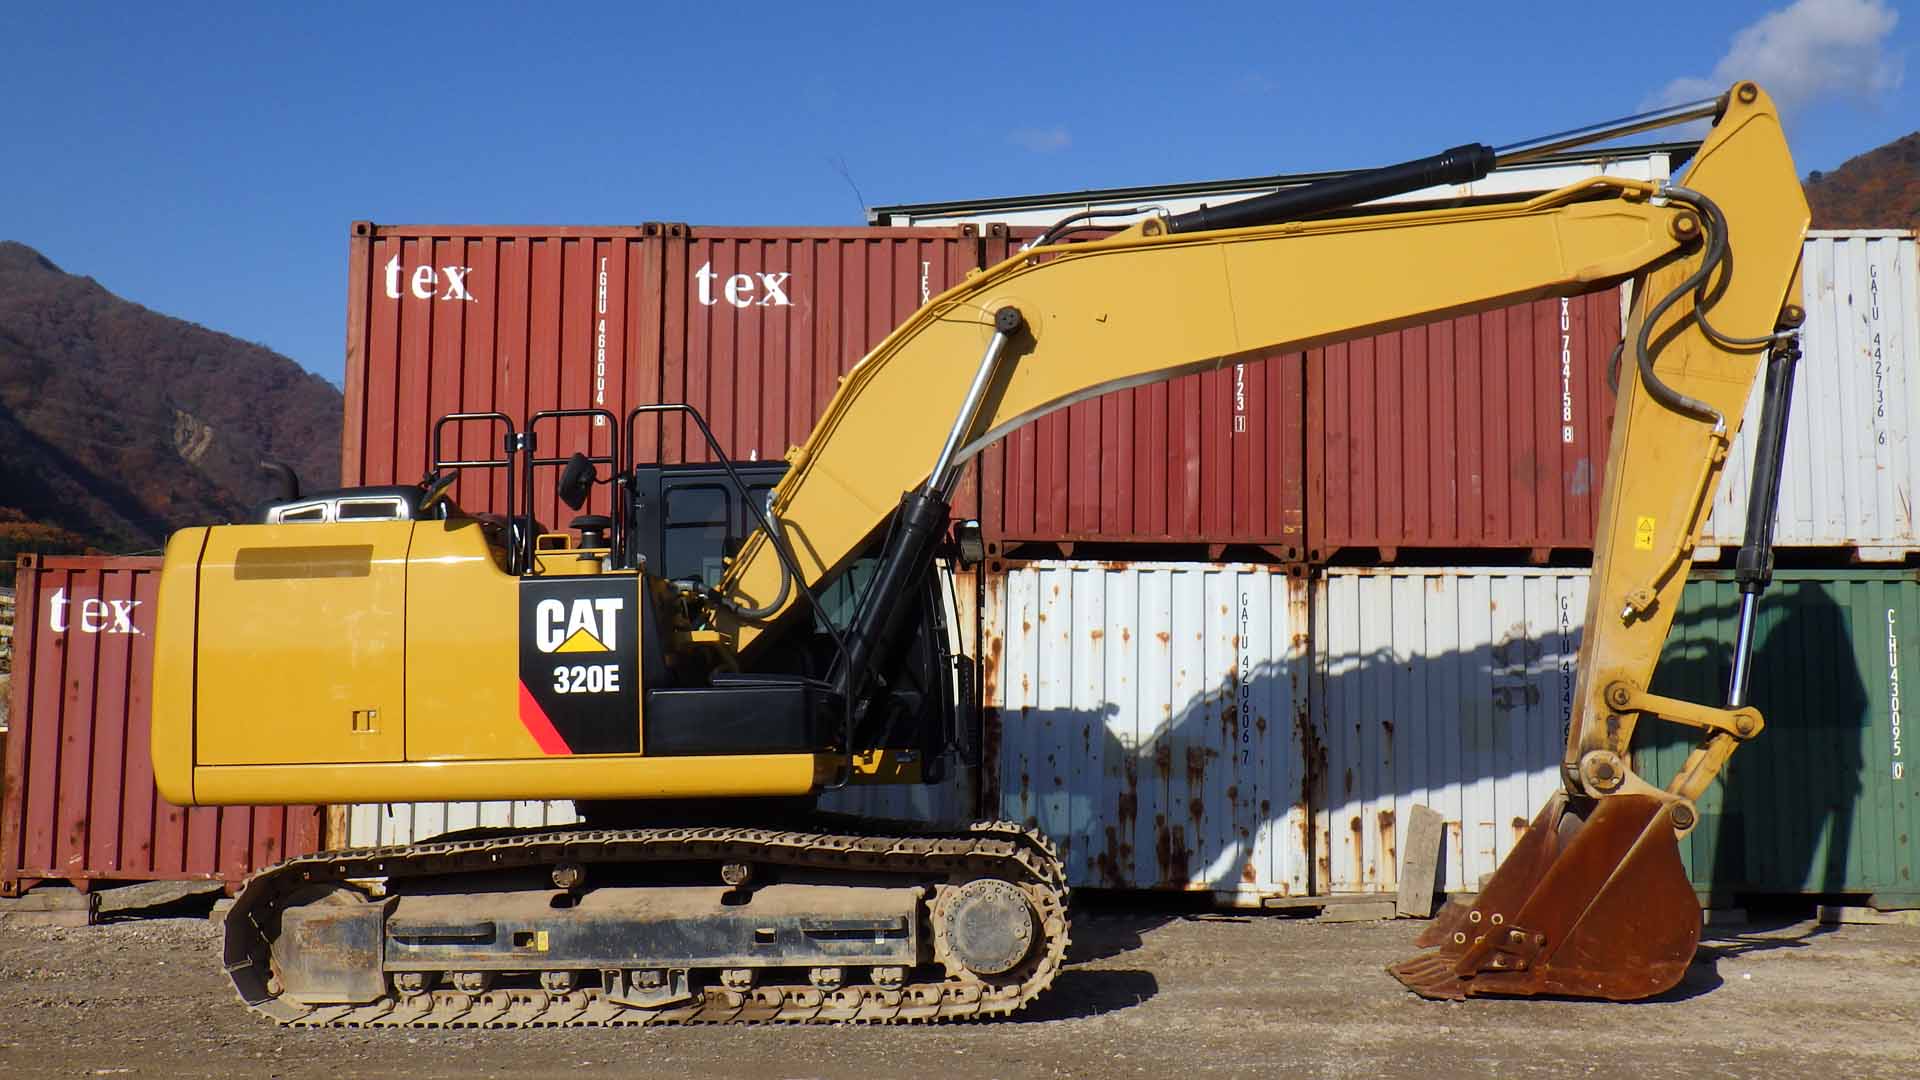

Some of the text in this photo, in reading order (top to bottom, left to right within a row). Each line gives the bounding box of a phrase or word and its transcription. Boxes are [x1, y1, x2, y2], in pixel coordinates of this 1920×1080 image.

[695, 260, 795, 308] tex
[597, 319, 605, 405] 468004
[1561, 297, 1573, 442] XU 704158 8
[1870, 264, 1885, 445] GATU 442736 6
[1236, 364, 1244, 411] 723
[50, 587, 142, 633] tex
[536, 598, 623, 653] CAT
[1561, 595, 1570, 655] GATU
[553, 664, 620, 694] 320E
[1242, 750, 1249, 765] 7
[1893, 762, 1904, 779] 0
